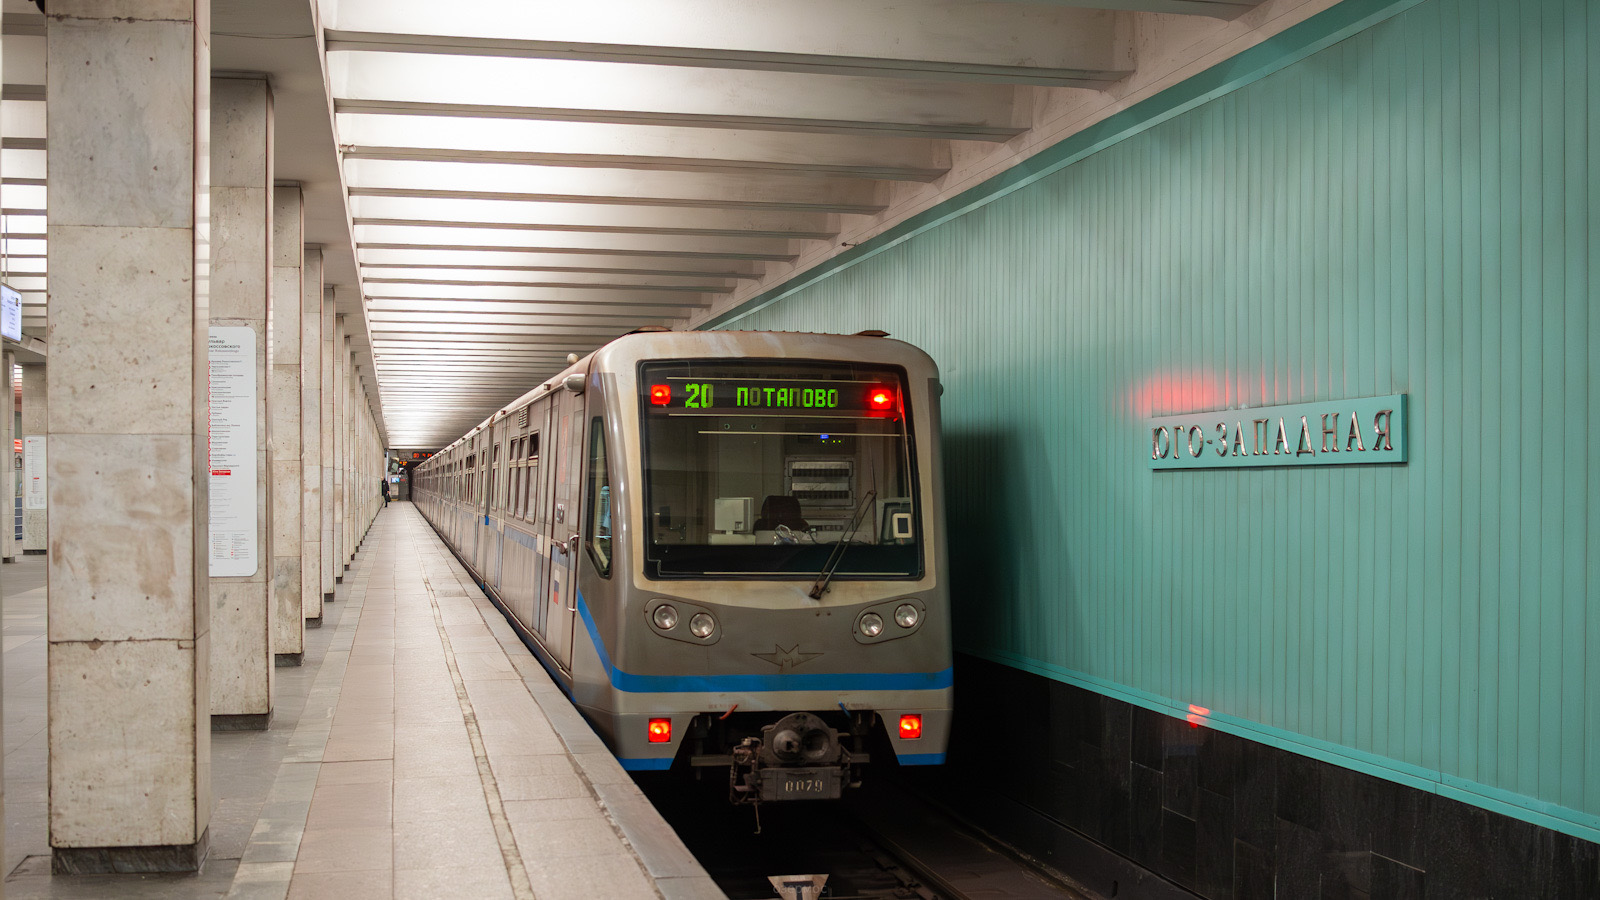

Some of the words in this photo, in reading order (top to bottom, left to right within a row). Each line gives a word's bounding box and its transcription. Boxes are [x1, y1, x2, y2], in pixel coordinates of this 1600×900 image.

[685, 383, 714, 409] 20
[736, 386, 839, 408] ПОТАПОВО
[1151, 409, 1394, 460] ЮГО-ЗАПАДНАЯ
[785, 779, 823, 792] 0079
